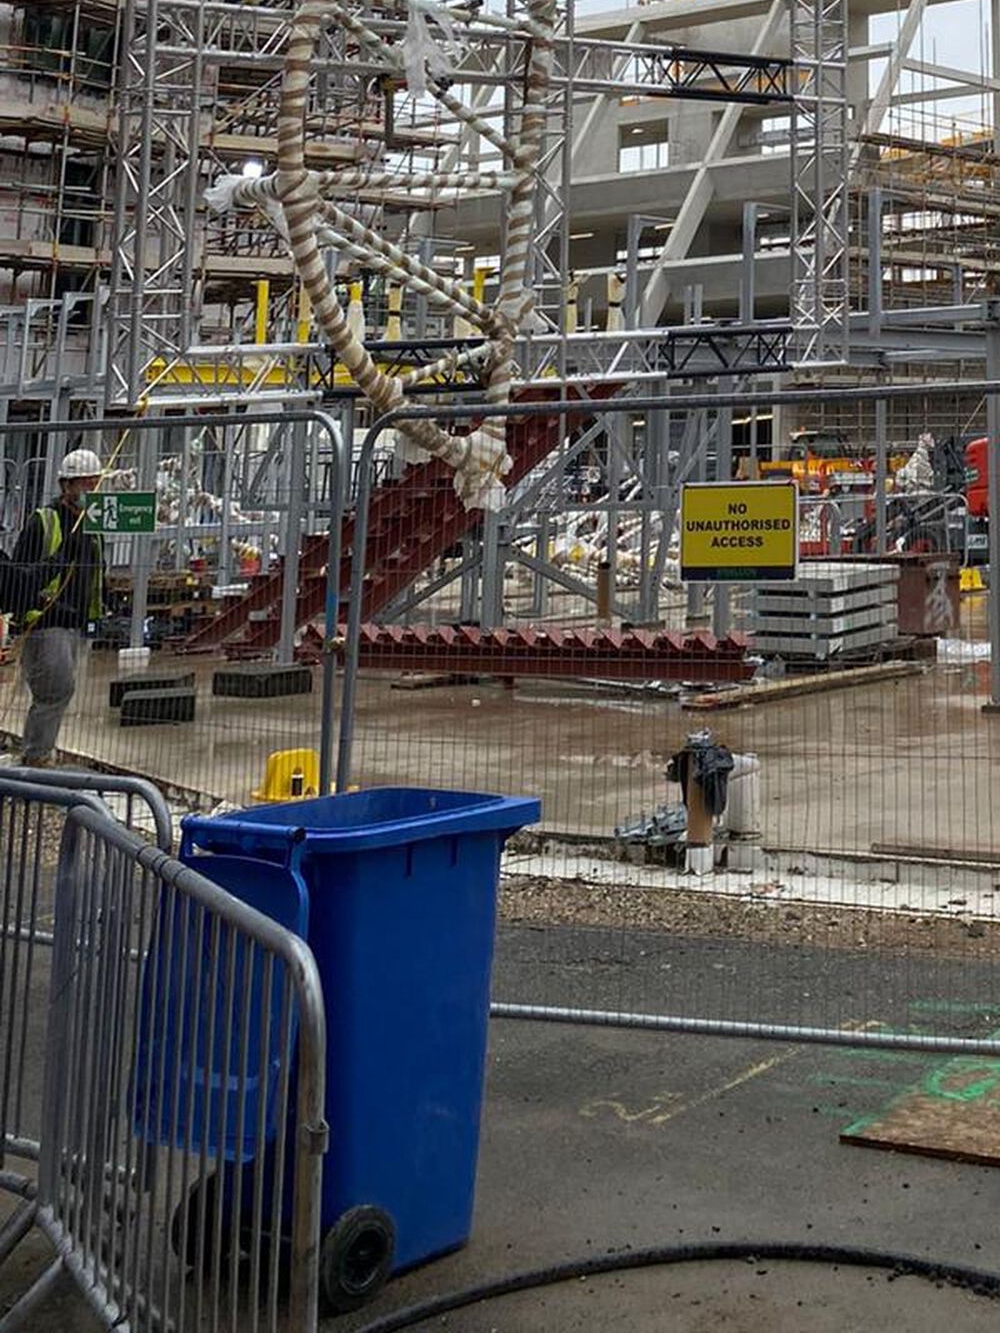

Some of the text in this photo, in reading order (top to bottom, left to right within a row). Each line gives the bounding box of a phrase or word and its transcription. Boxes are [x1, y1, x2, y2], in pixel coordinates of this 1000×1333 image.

[728, 504, 747, 514] NO
[686, 519, 791, 532] UNAUTHORISED
[711, 536, 763, 547] ACCESS
